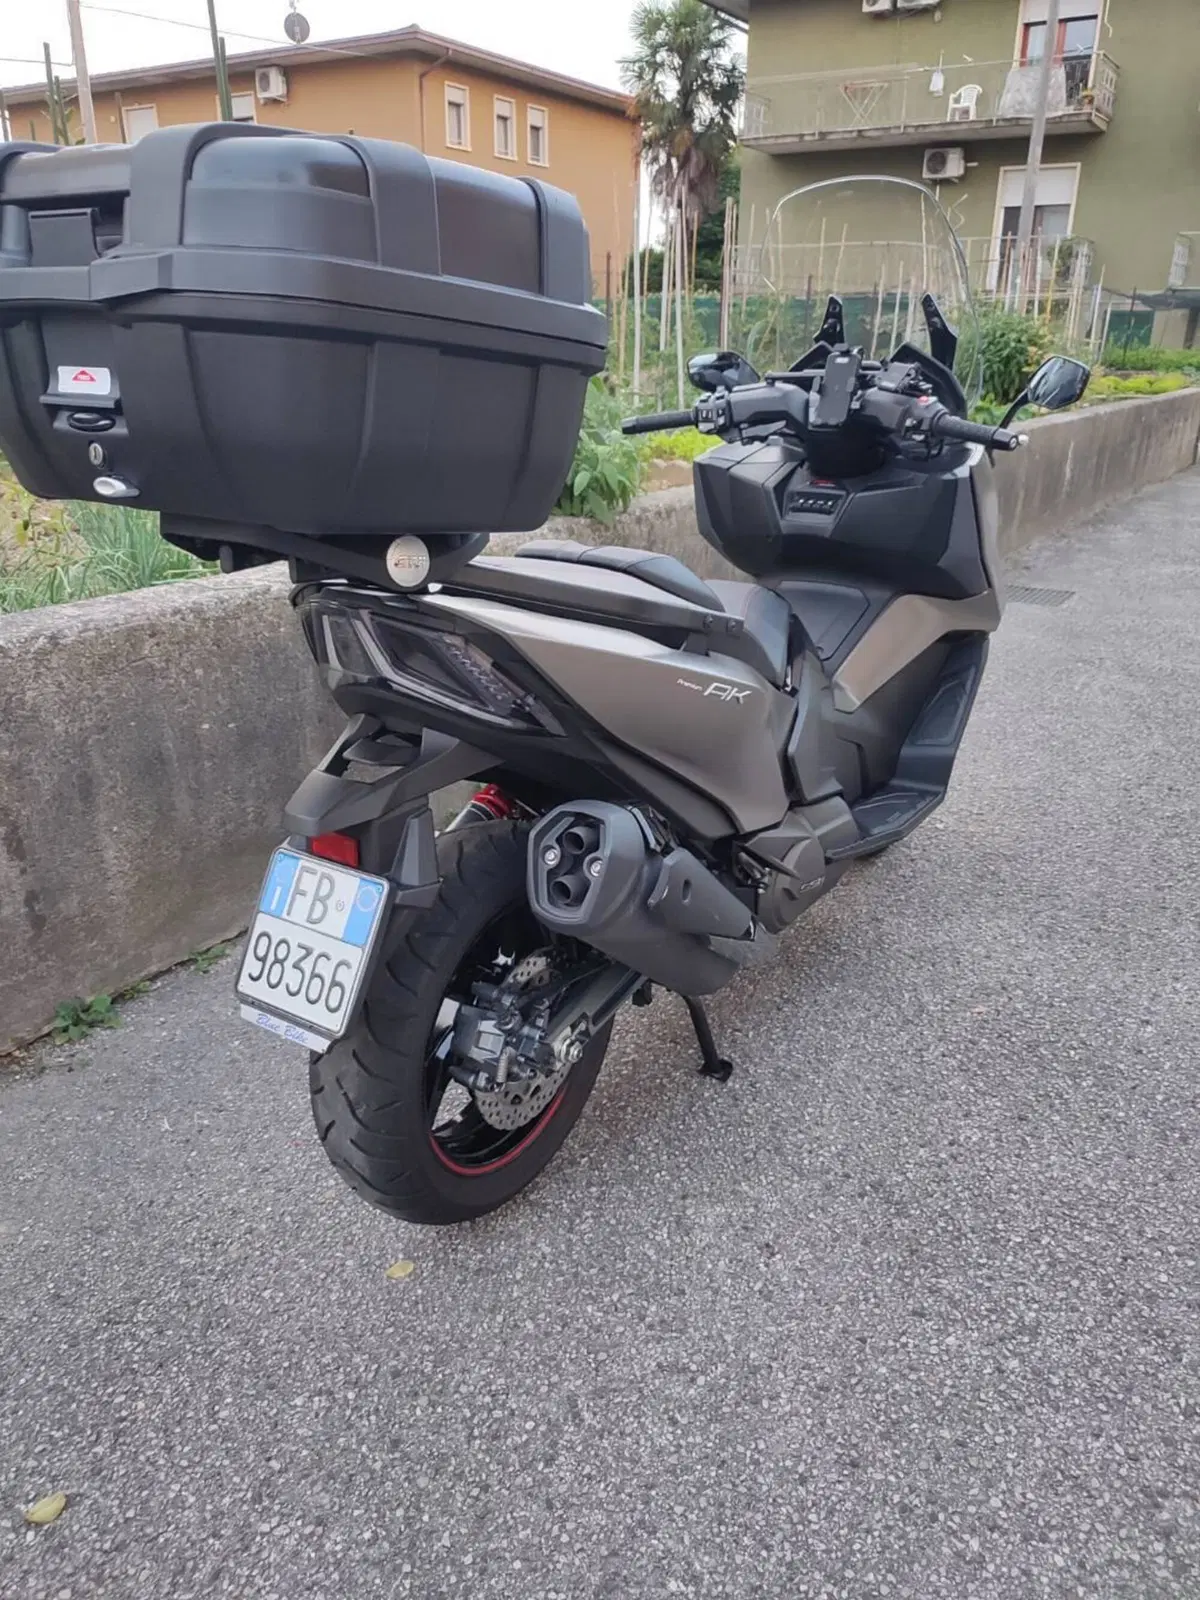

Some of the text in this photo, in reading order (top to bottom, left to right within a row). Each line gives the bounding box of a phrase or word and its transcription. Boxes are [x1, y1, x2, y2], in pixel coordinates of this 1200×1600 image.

[286, 864, 335, 925] FB
[248, 930, 352, 1014] 98366
[256, 1013, 281, 1032] Blue
